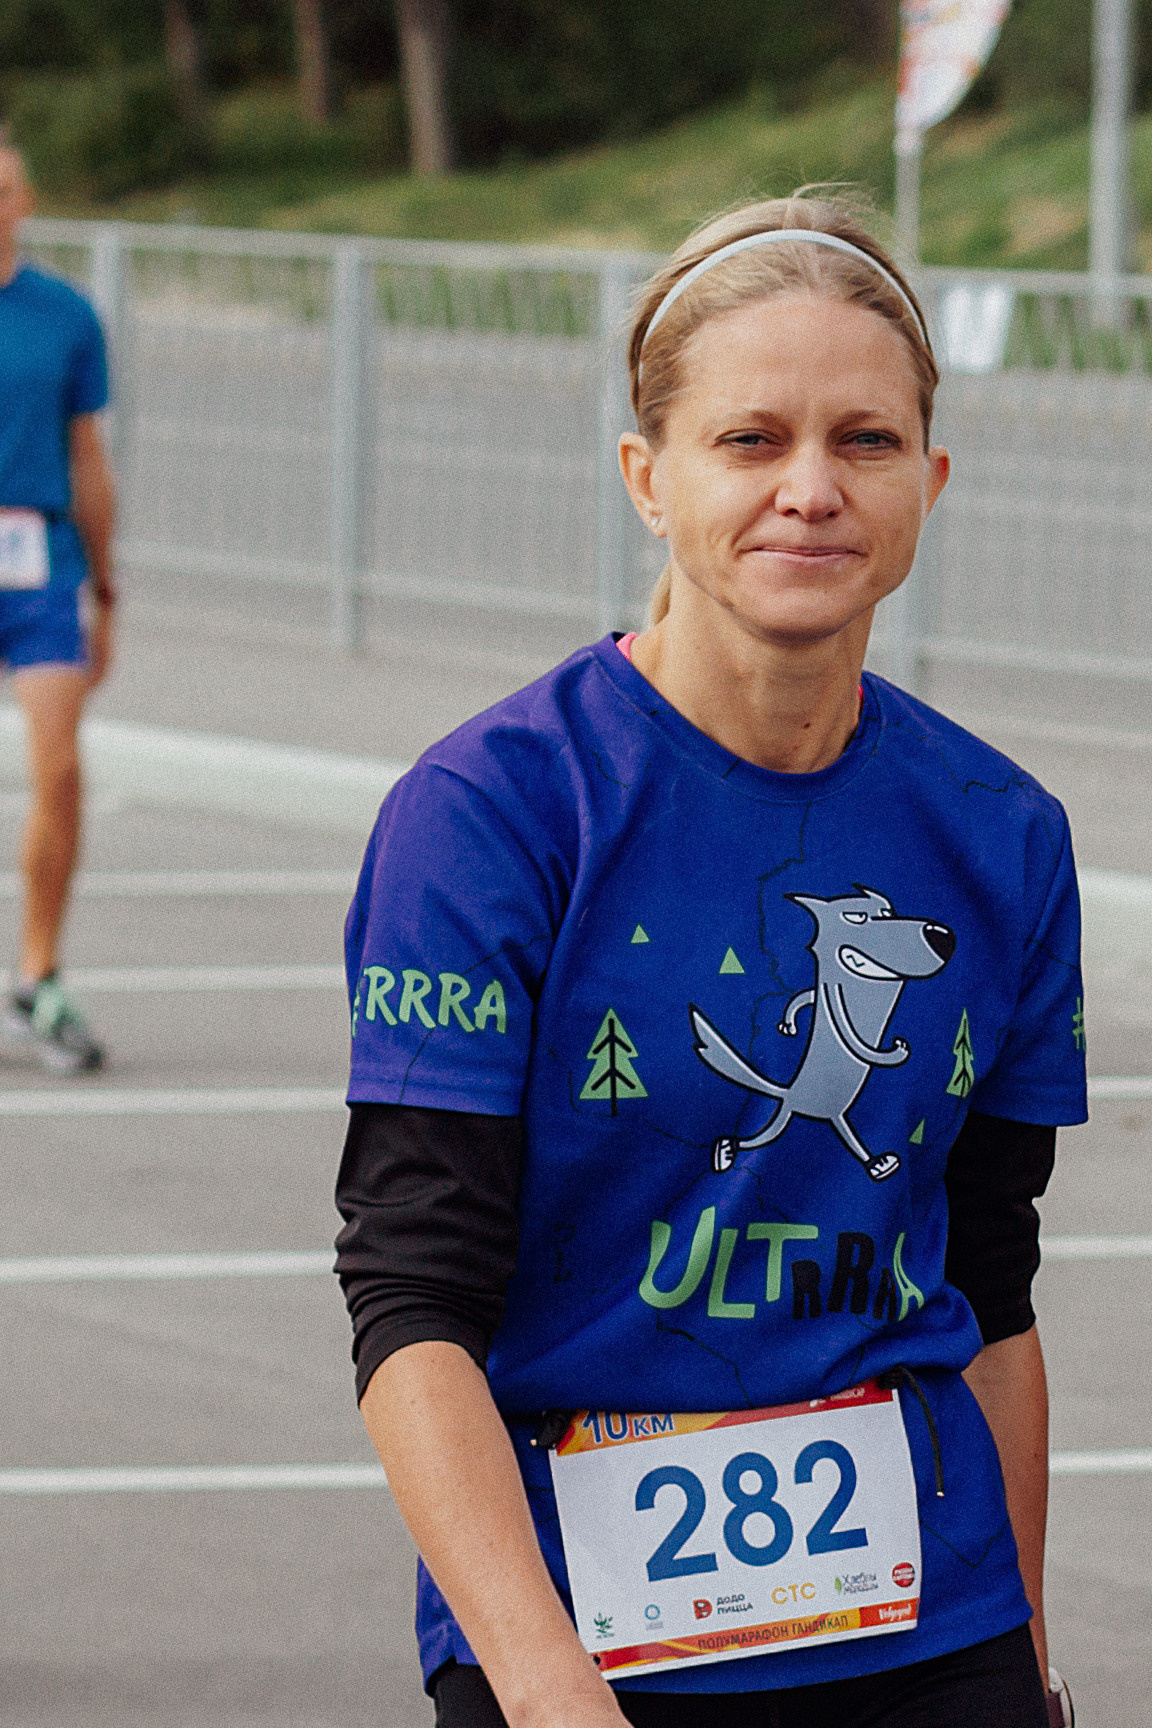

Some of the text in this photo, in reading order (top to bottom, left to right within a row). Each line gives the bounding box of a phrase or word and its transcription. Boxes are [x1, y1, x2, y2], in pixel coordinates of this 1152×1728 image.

[352, 965, 507, 1035] RRRA
[634, 1439, 869, 1582] 282
[716, 1593, 745, 1606] ДОДО
[717, 1602, 753, 1615] ПИЦЦА
[698, 1614, 849, 1651] ПОЛУМАРАФОН ГАНДИКАП
